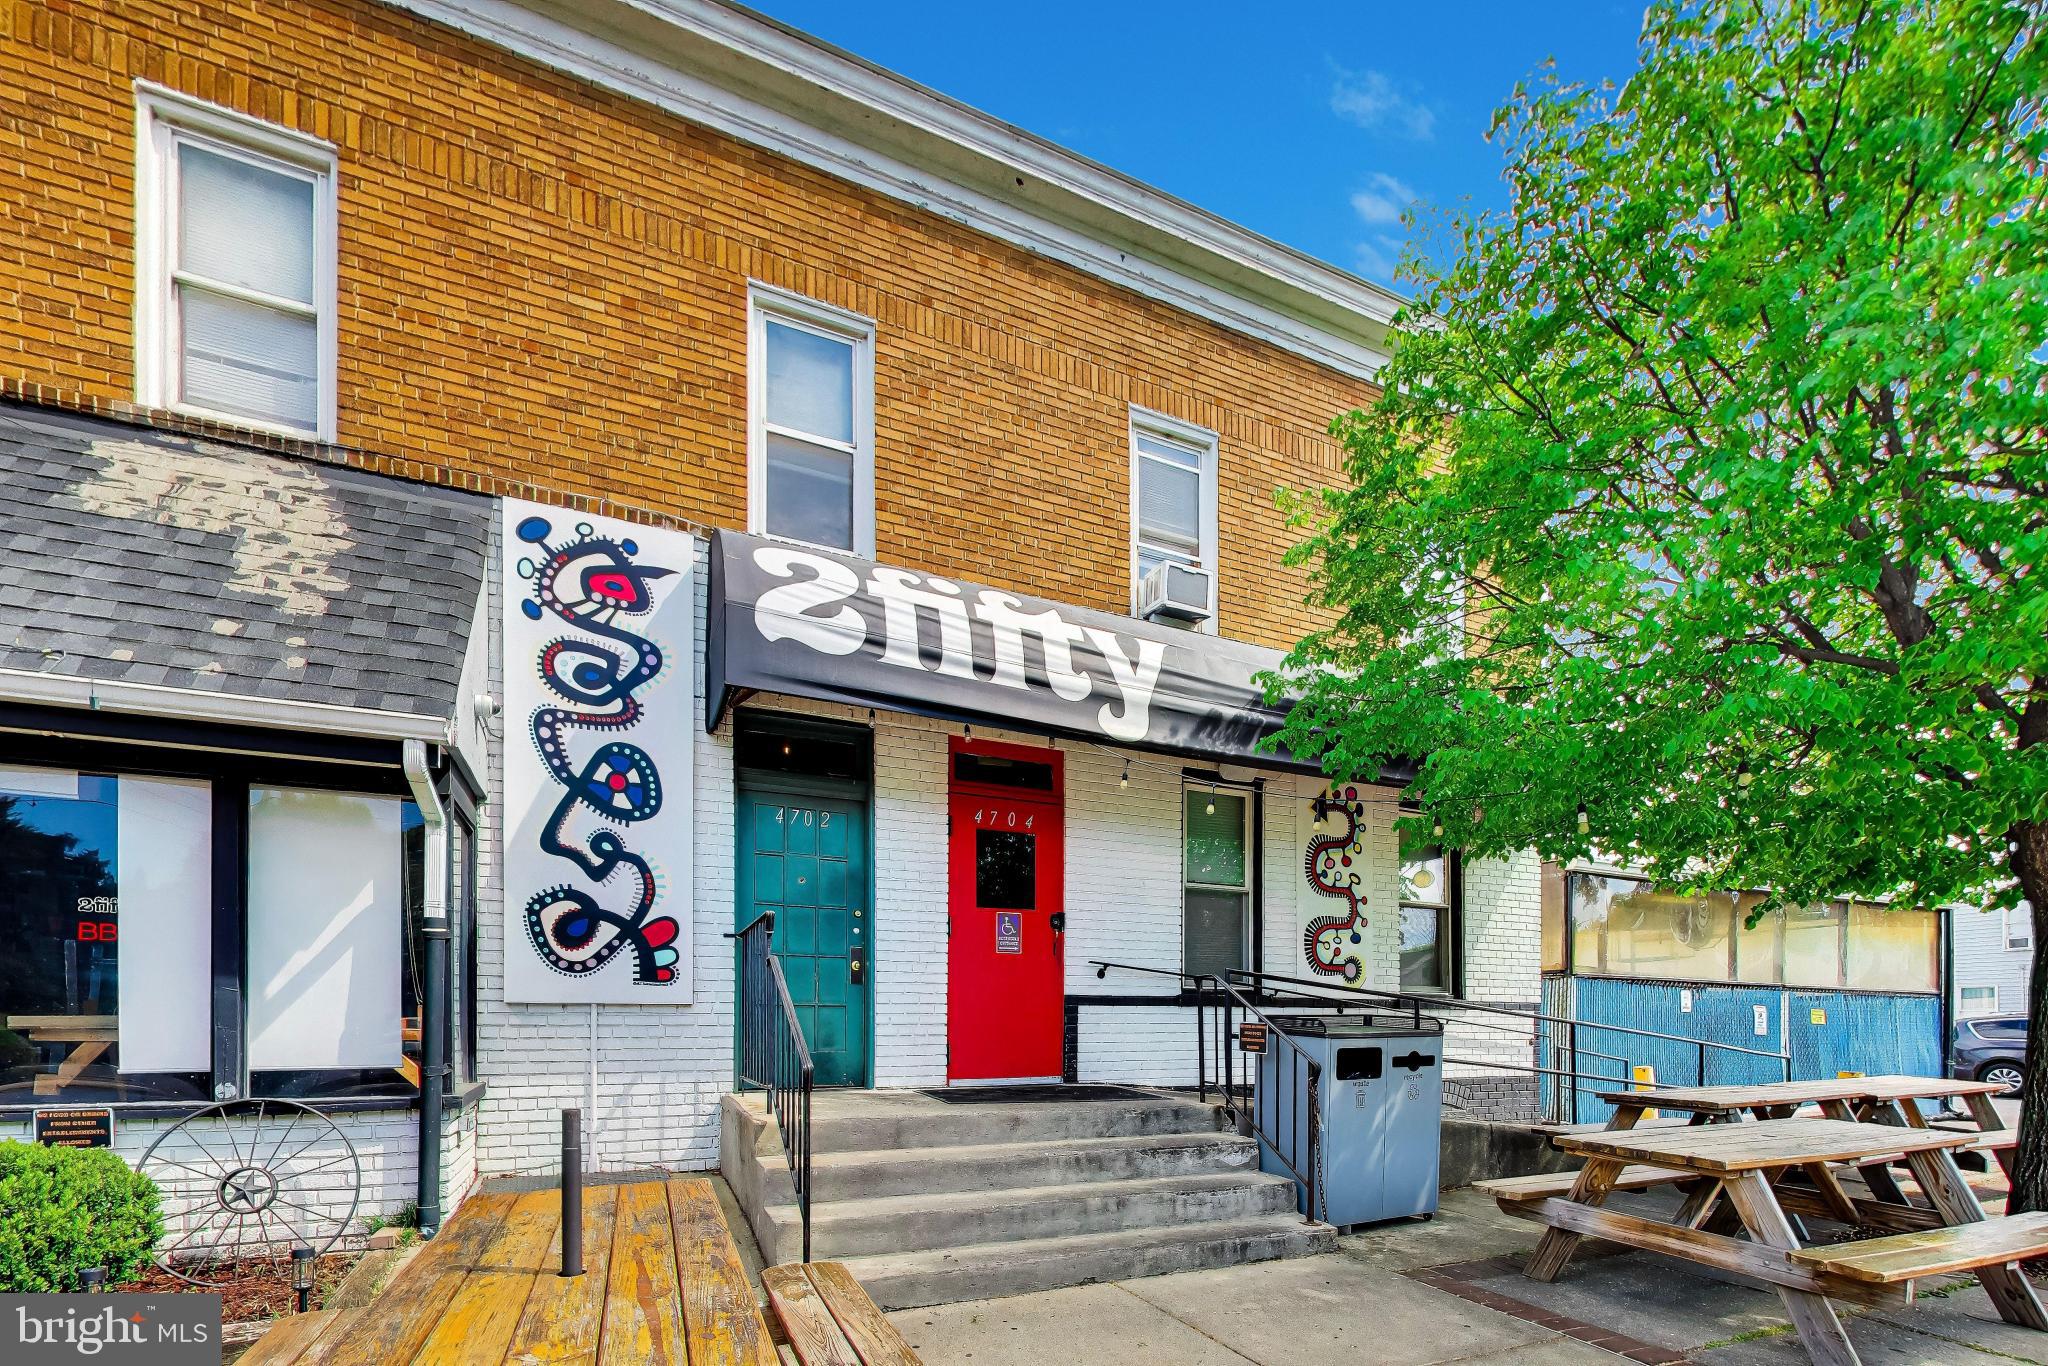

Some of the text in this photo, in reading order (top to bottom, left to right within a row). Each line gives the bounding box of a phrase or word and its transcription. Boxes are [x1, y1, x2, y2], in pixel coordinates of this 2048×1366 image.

[753, 547, 1169, 742] 2fifty
[775, 807, 831, 828] 4702
[974, 809, 1034, 829] 4704
